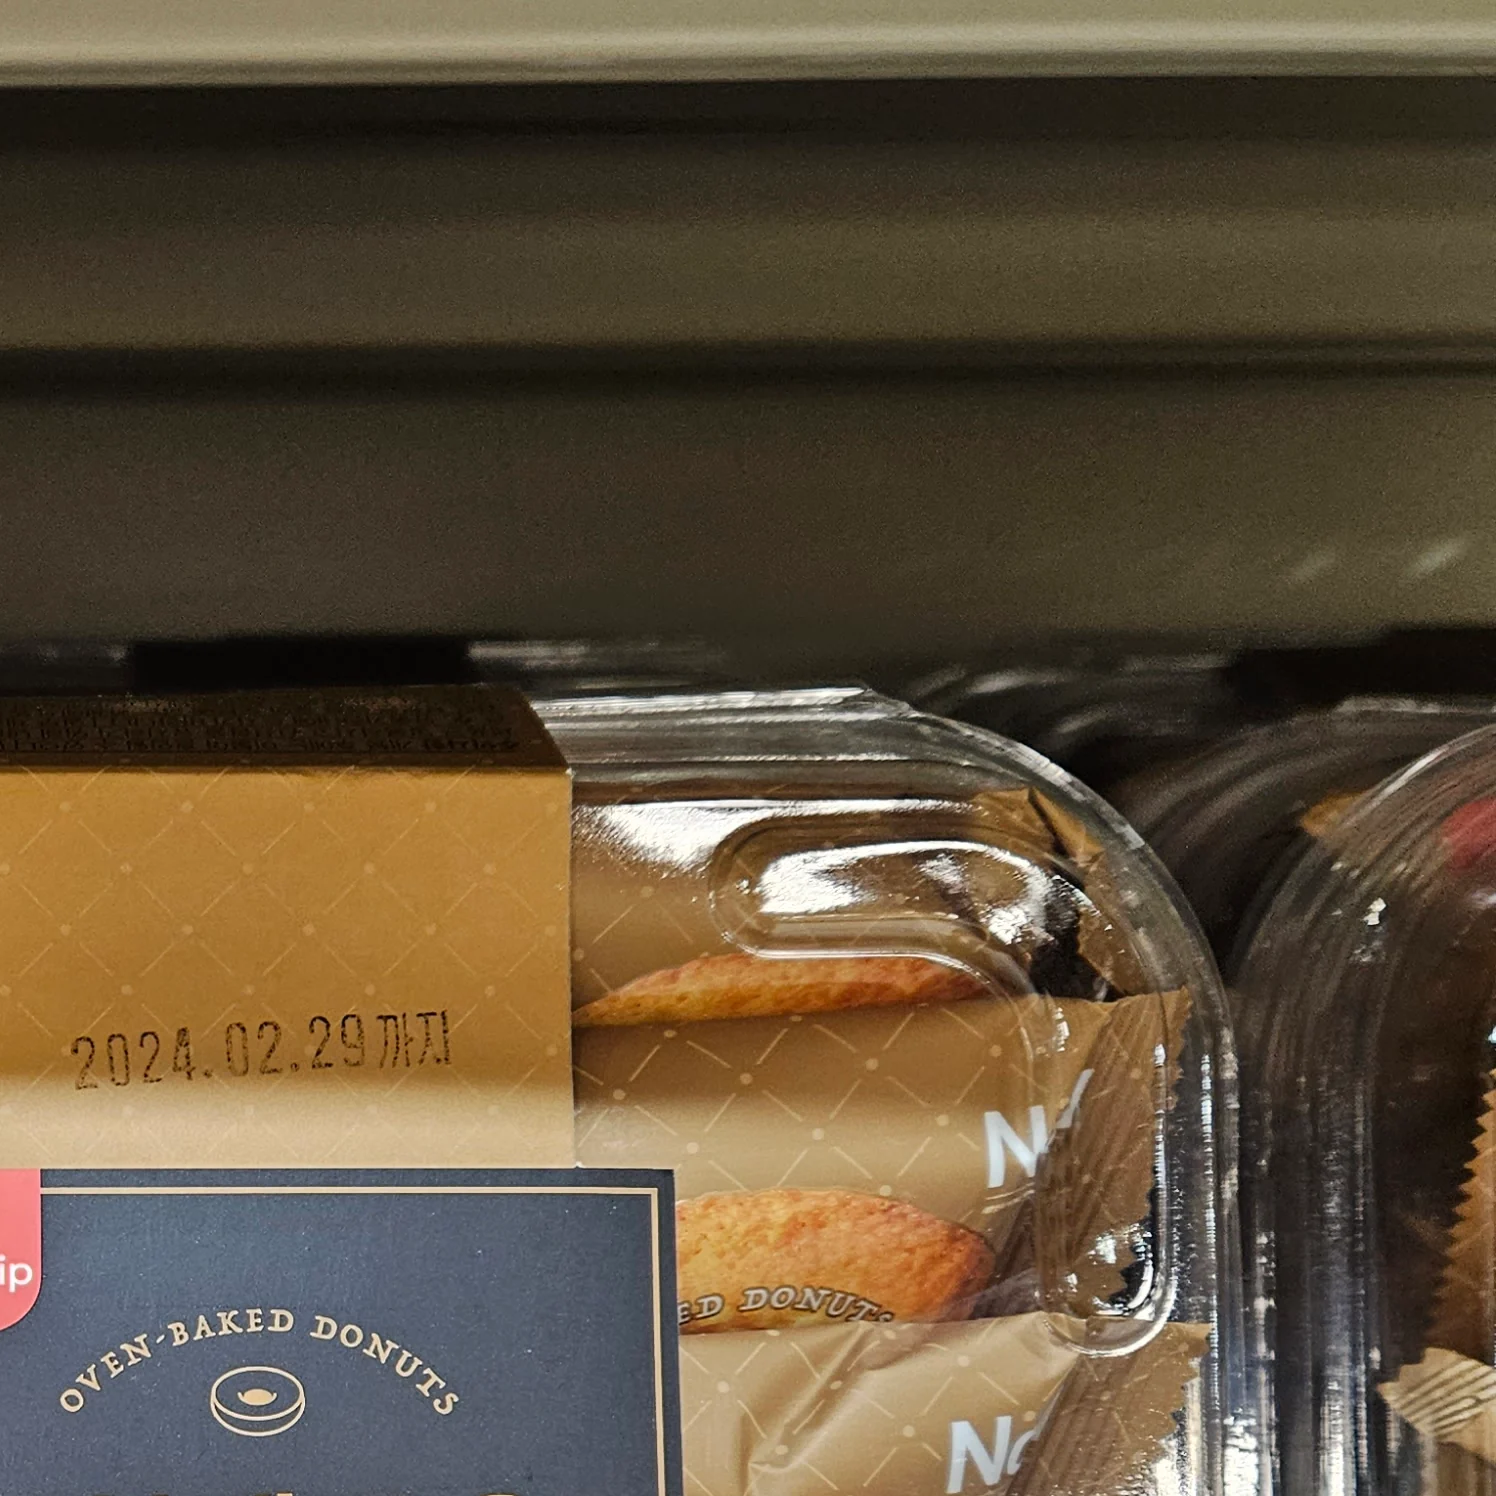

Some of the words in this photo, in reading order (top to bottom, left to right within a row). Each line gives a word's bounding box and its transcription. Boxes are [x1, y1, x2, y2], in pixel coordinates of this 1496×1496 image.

[70, 1009, 454, 1091] 2024.02.29까지
[58, 1307, 295, 1414] OVEN-BAKED
[308, 1314, 461, 1417] DONUTS
